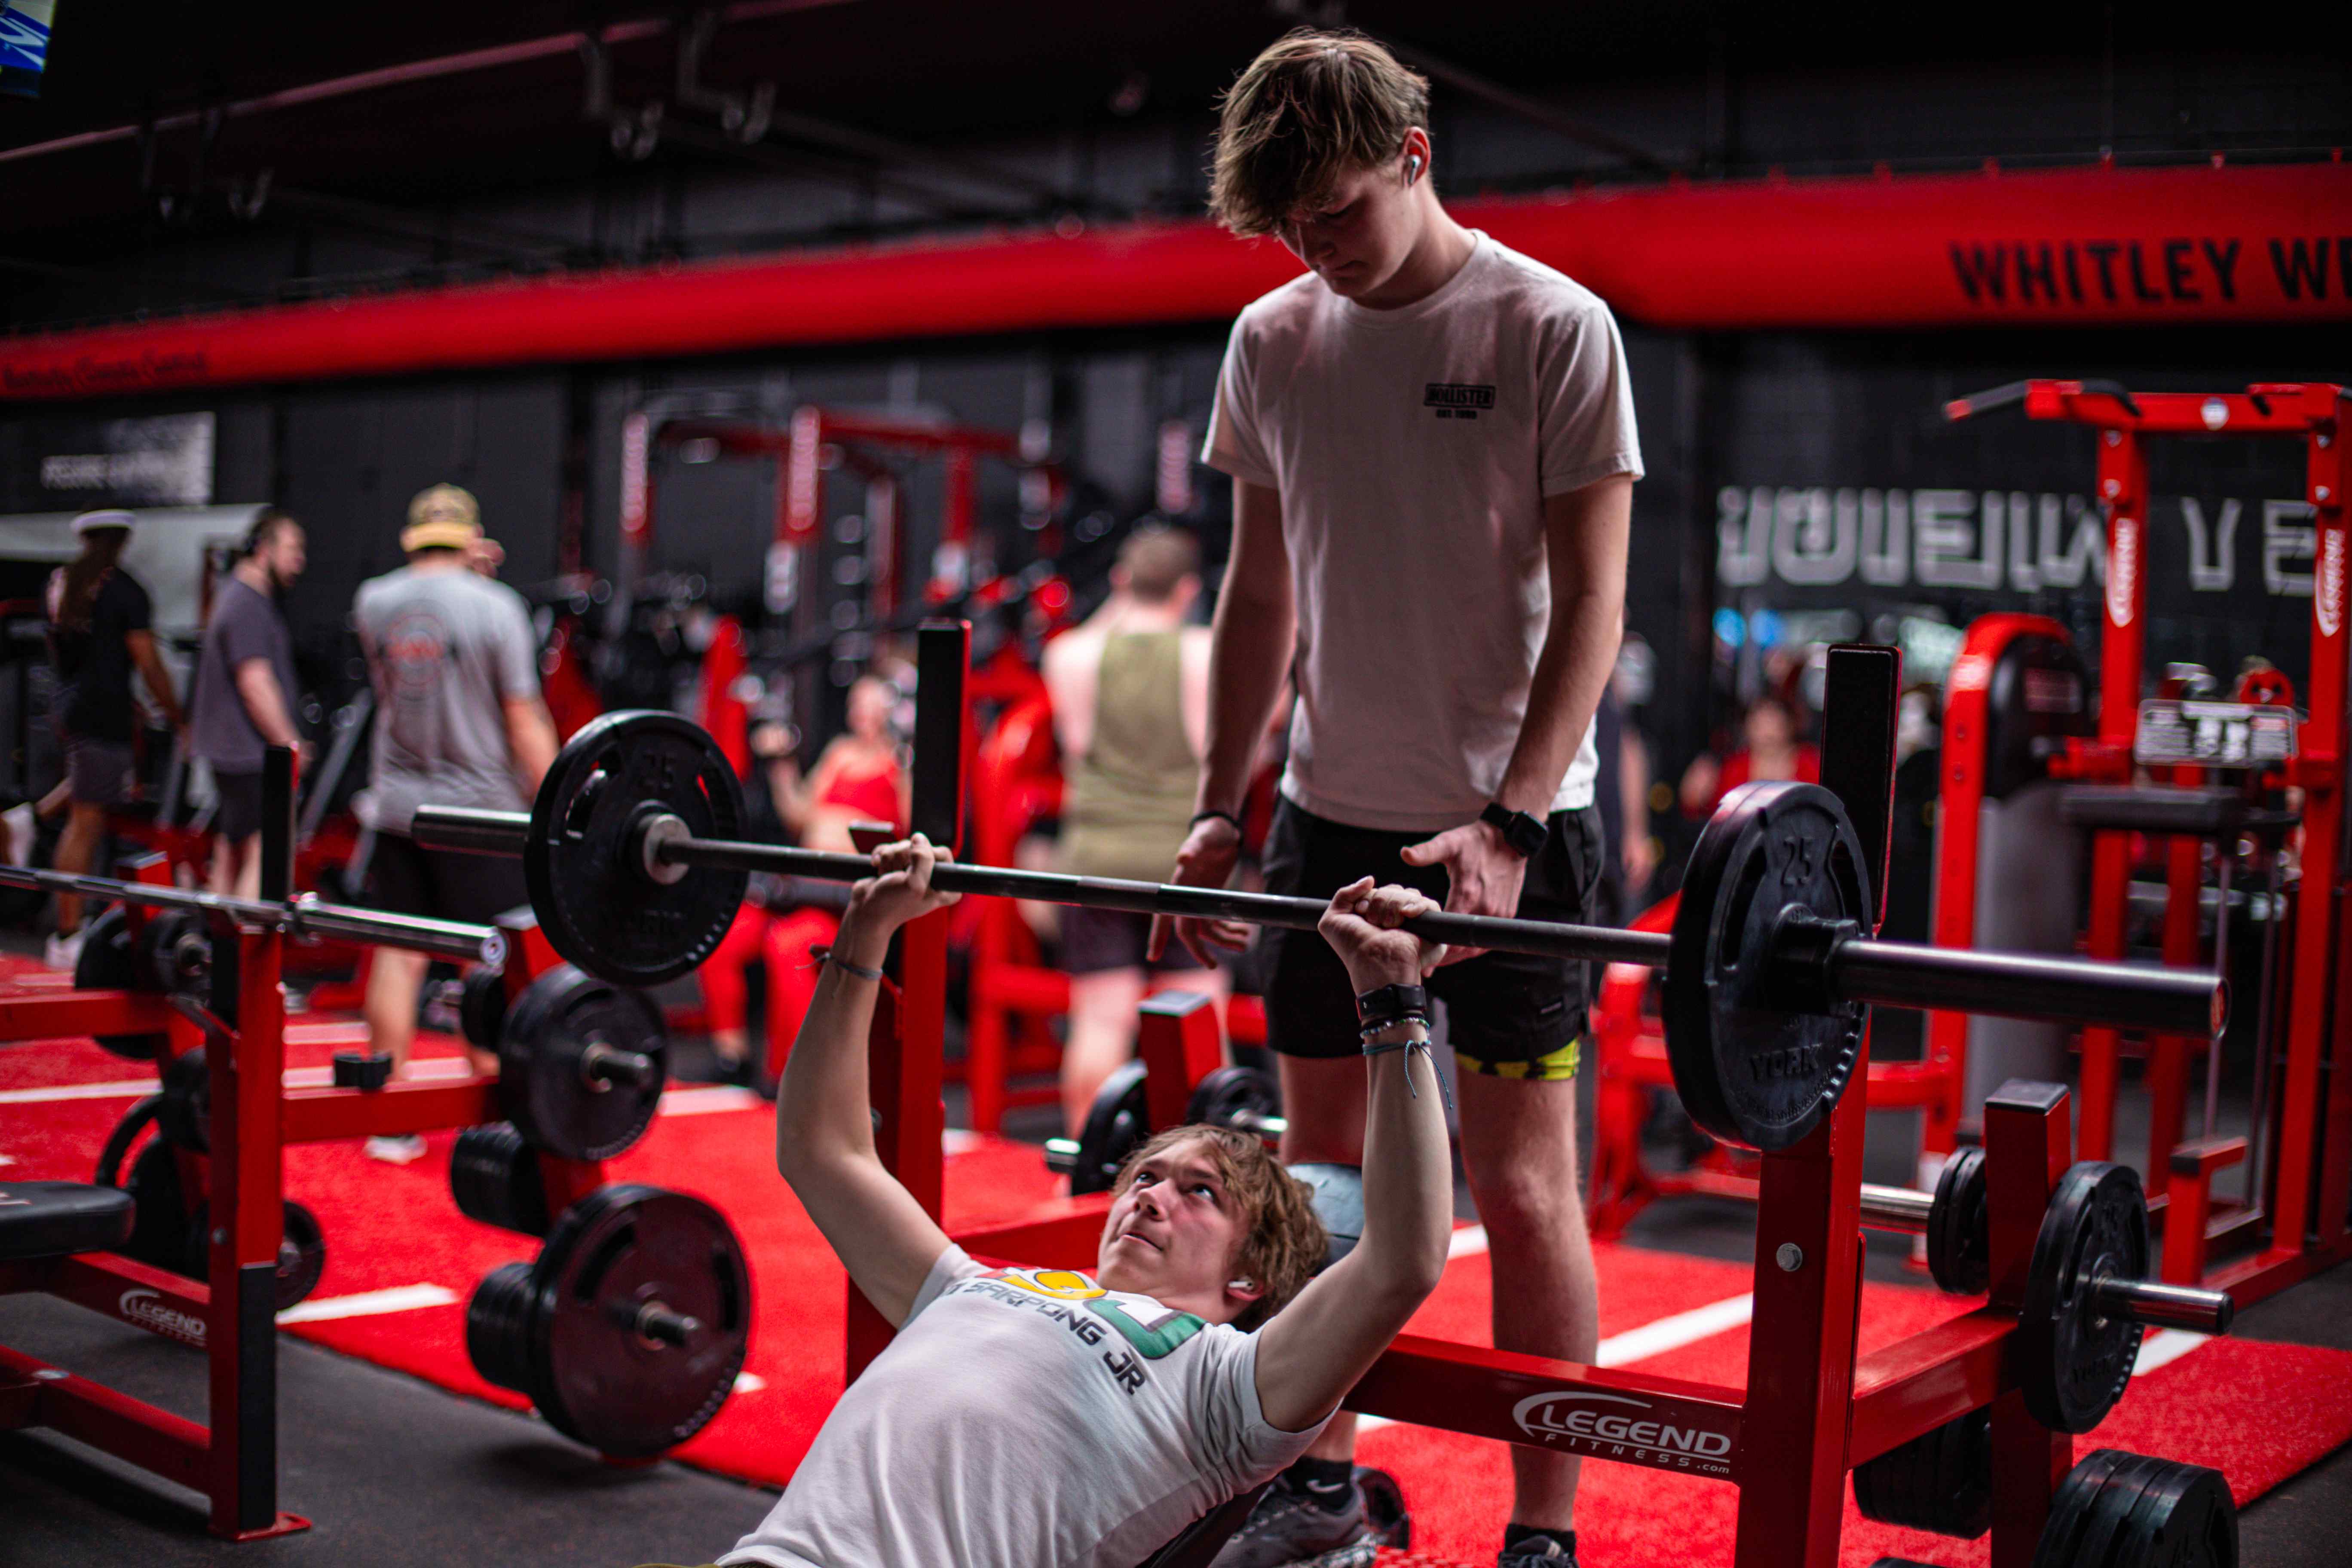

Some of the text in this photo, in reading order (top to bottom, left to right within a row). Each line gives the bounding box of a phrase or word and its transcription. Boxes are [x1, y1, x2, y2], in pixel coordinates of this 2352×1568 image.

[1950, 238, 2239, 303] WHITLEY
[1780, 836, 1814, 886] 25
[1749, 1043, 1822, 1080] YORK
[963, 1282, 1108, 1346] SARPONG
[1103, 1351, 1145, 1395] JR
[1543, 1404, 1731, 1455] LEGEND
